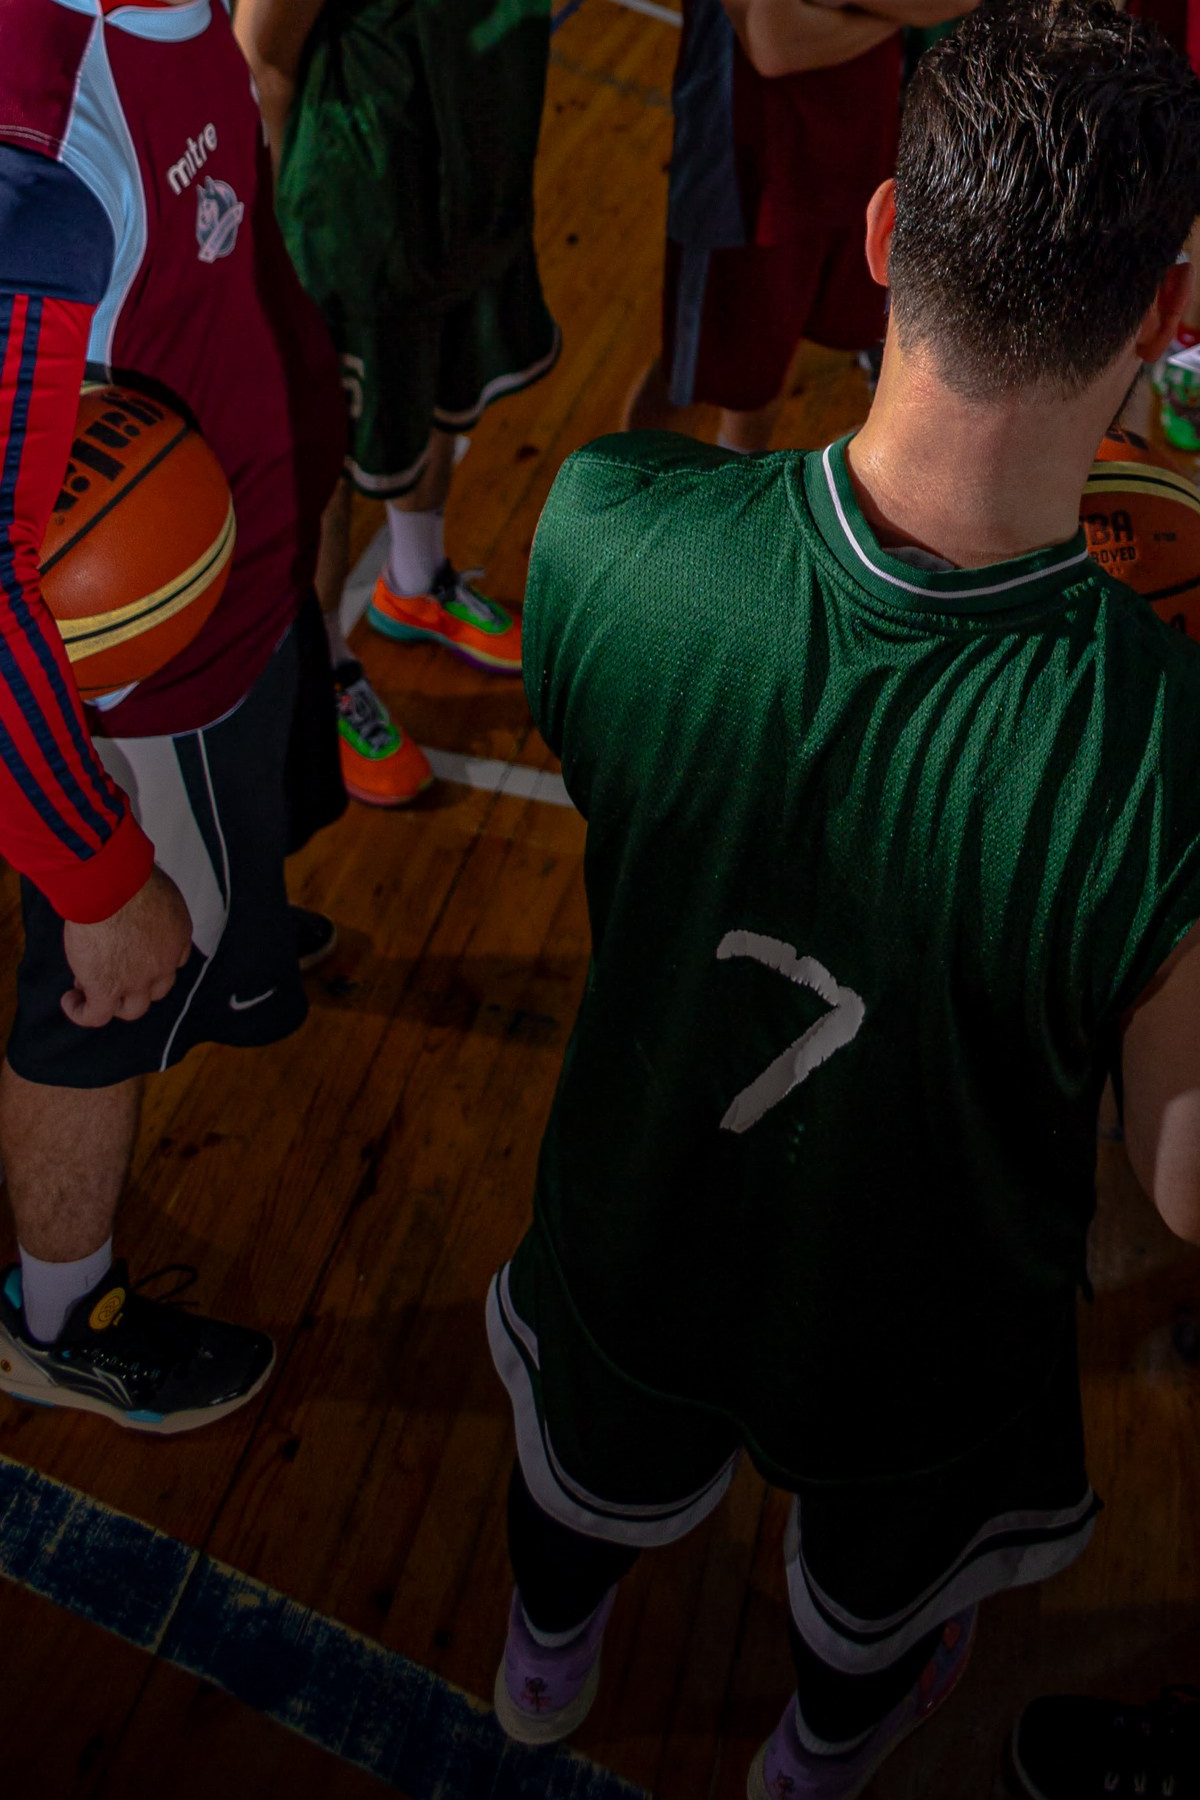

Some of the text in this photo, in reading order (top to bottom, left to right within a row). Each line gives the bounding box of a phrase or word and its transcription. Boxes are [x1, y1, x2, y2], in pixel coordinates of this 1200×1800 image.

[166, 122, 218, 196] mitre
[1080, 509, 1134, 546] BA
[715, 928, 866, 1135] 7
